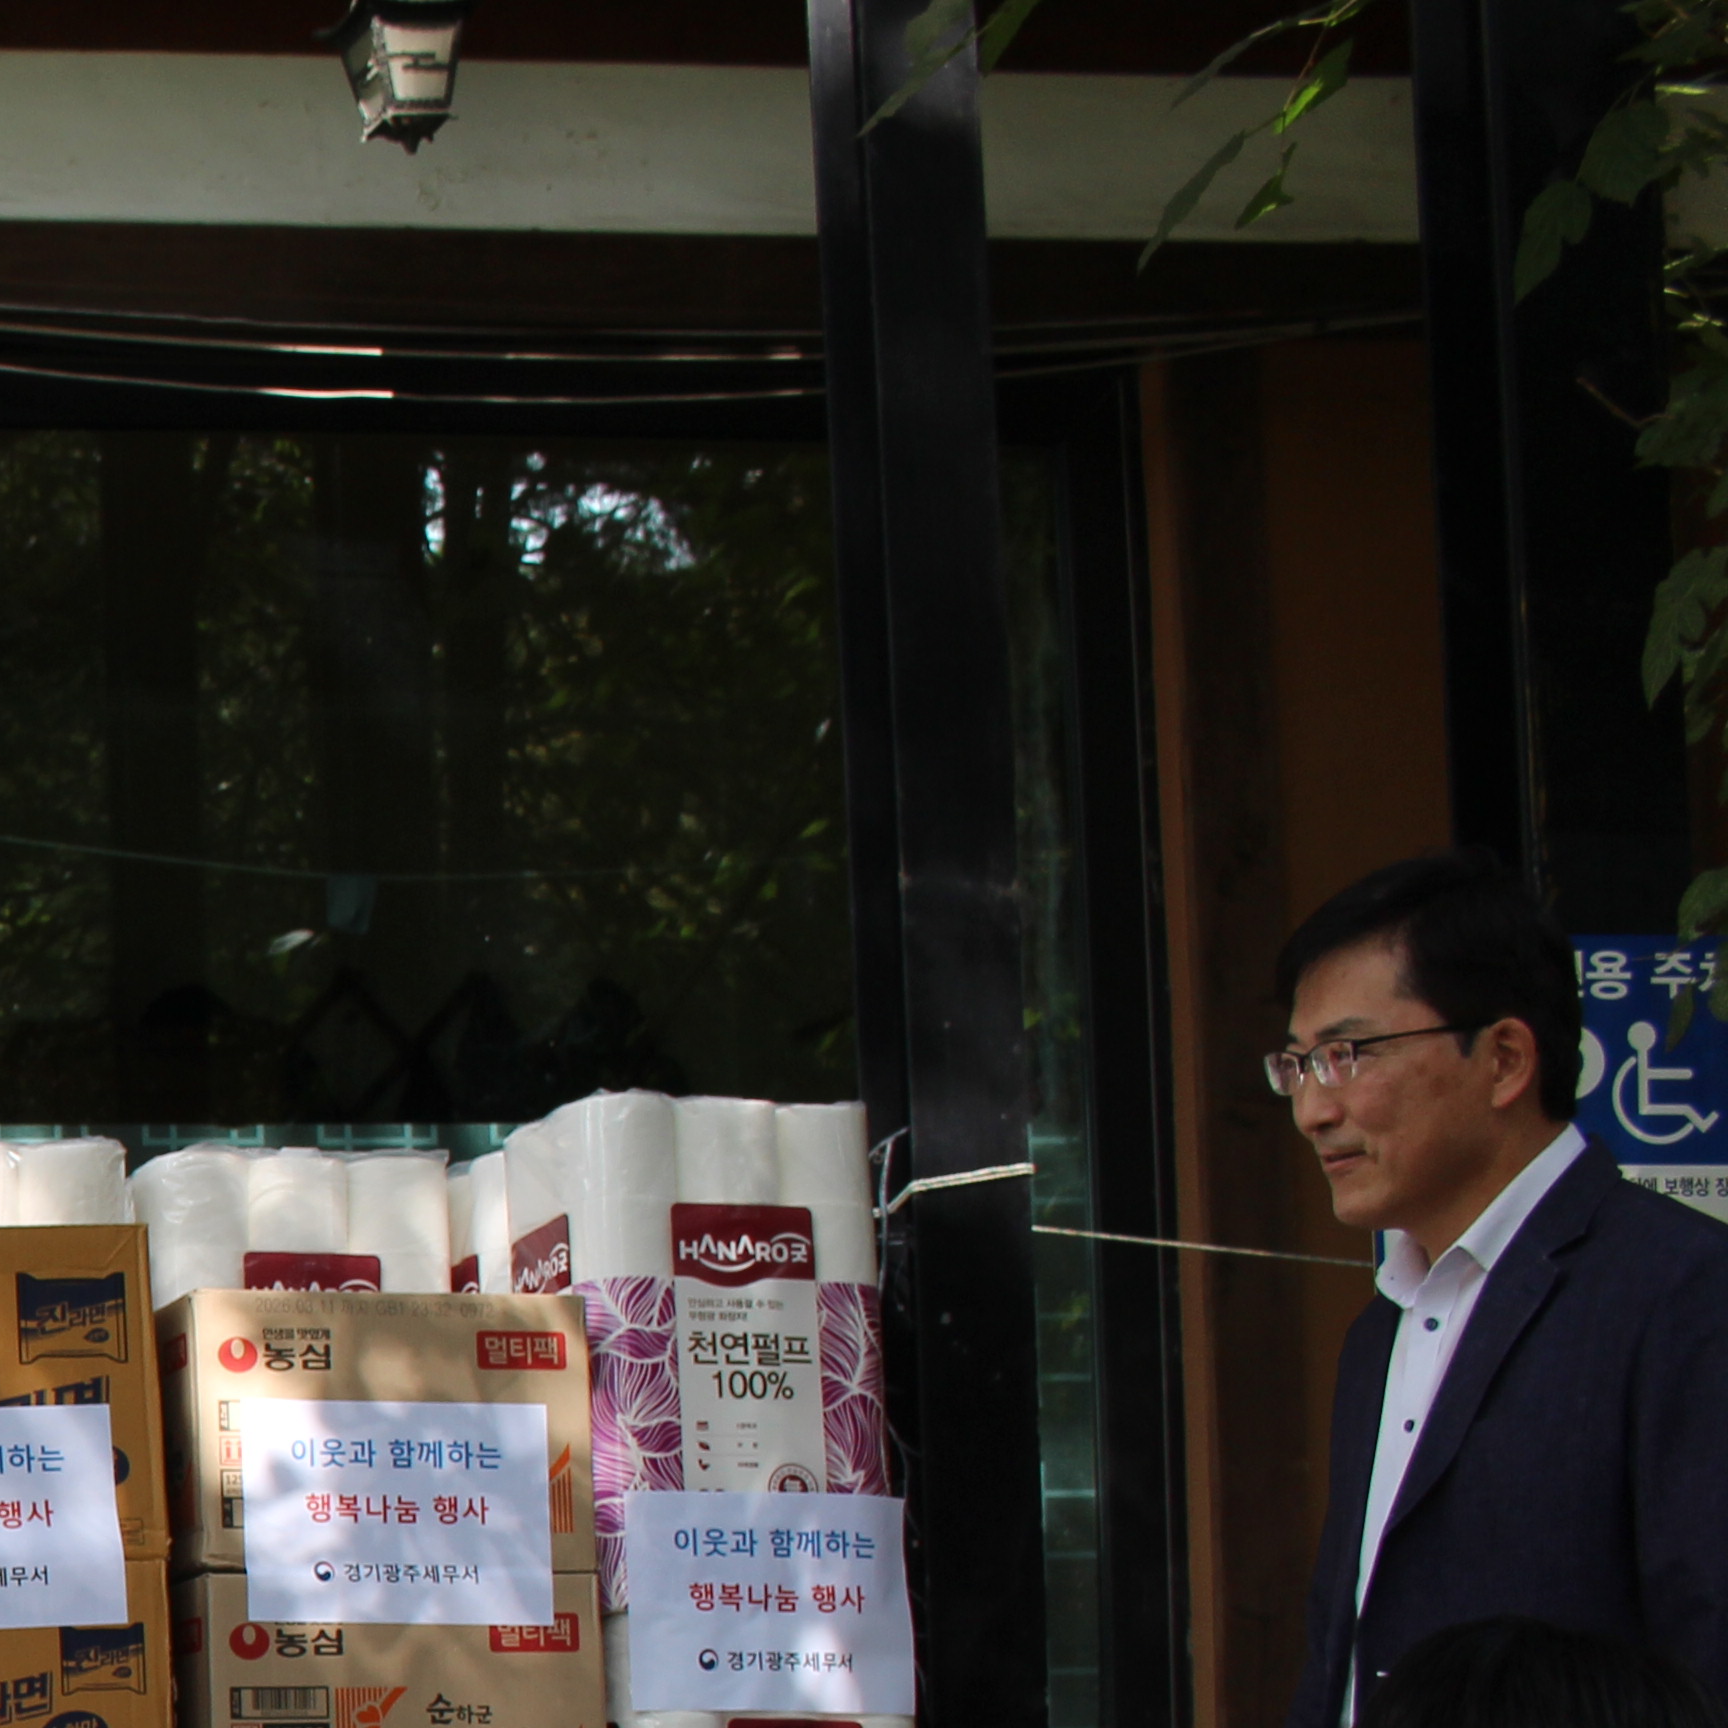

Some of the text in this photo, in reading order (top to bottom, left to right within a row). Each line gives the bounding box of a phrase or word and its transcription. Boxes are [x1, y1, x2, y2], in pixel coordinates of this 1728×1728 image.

[1575, 951, 1631, 1000] 용
[262, 1343, 332, 1371] 농심
[483, 1335, 560, 1366] 멀티팩
[687, 1330, 813, 1366] 천연펄프
[712, 1369, 795, 1400] 100%
[290, 1437, 504, 1471] 이웃과 함께하는
[305, 1492, 491, 1526] 행복나눔 행사
[673, 1527, 877, 1560] 이웃과 함께하는
[343, 1562, 481, 1585] 경기광주세무서
[688, 1582, 866, 1615] 행복나눔 행사
[274, 1628, 345, 1658] 농심
[726, 1650, 854, 1674] 경기광주세무서
[425, 1693, 494, 1726] 순하군
